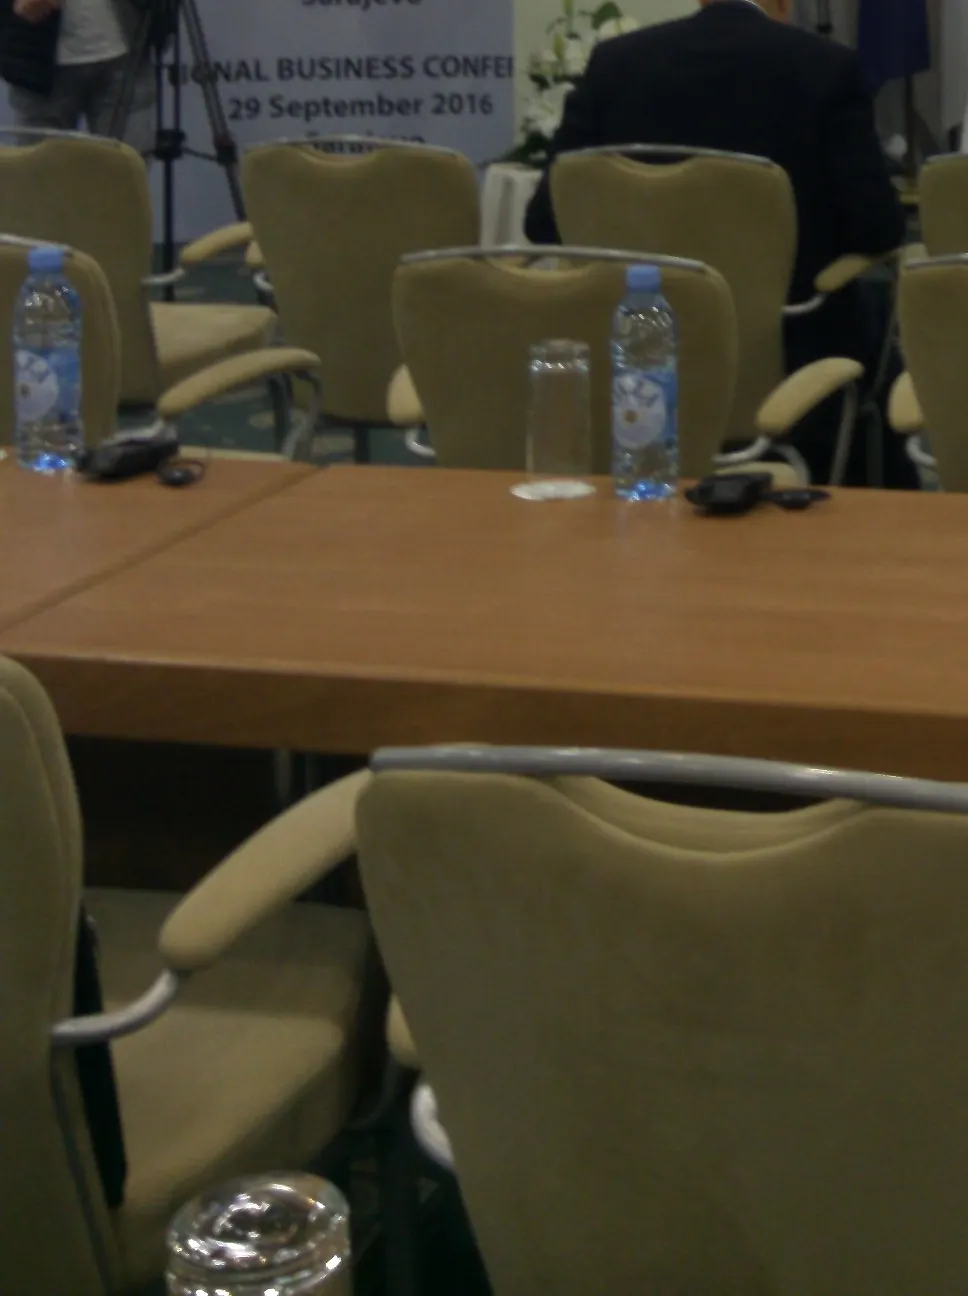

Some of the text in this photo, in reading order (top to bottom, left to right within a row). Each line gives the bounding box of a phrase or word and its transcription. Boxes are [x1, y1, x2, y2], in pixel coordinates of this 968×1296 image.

[276, 56, 415, 82] BUSINESS
[228, 92, 494, 123] 29 September 2016
